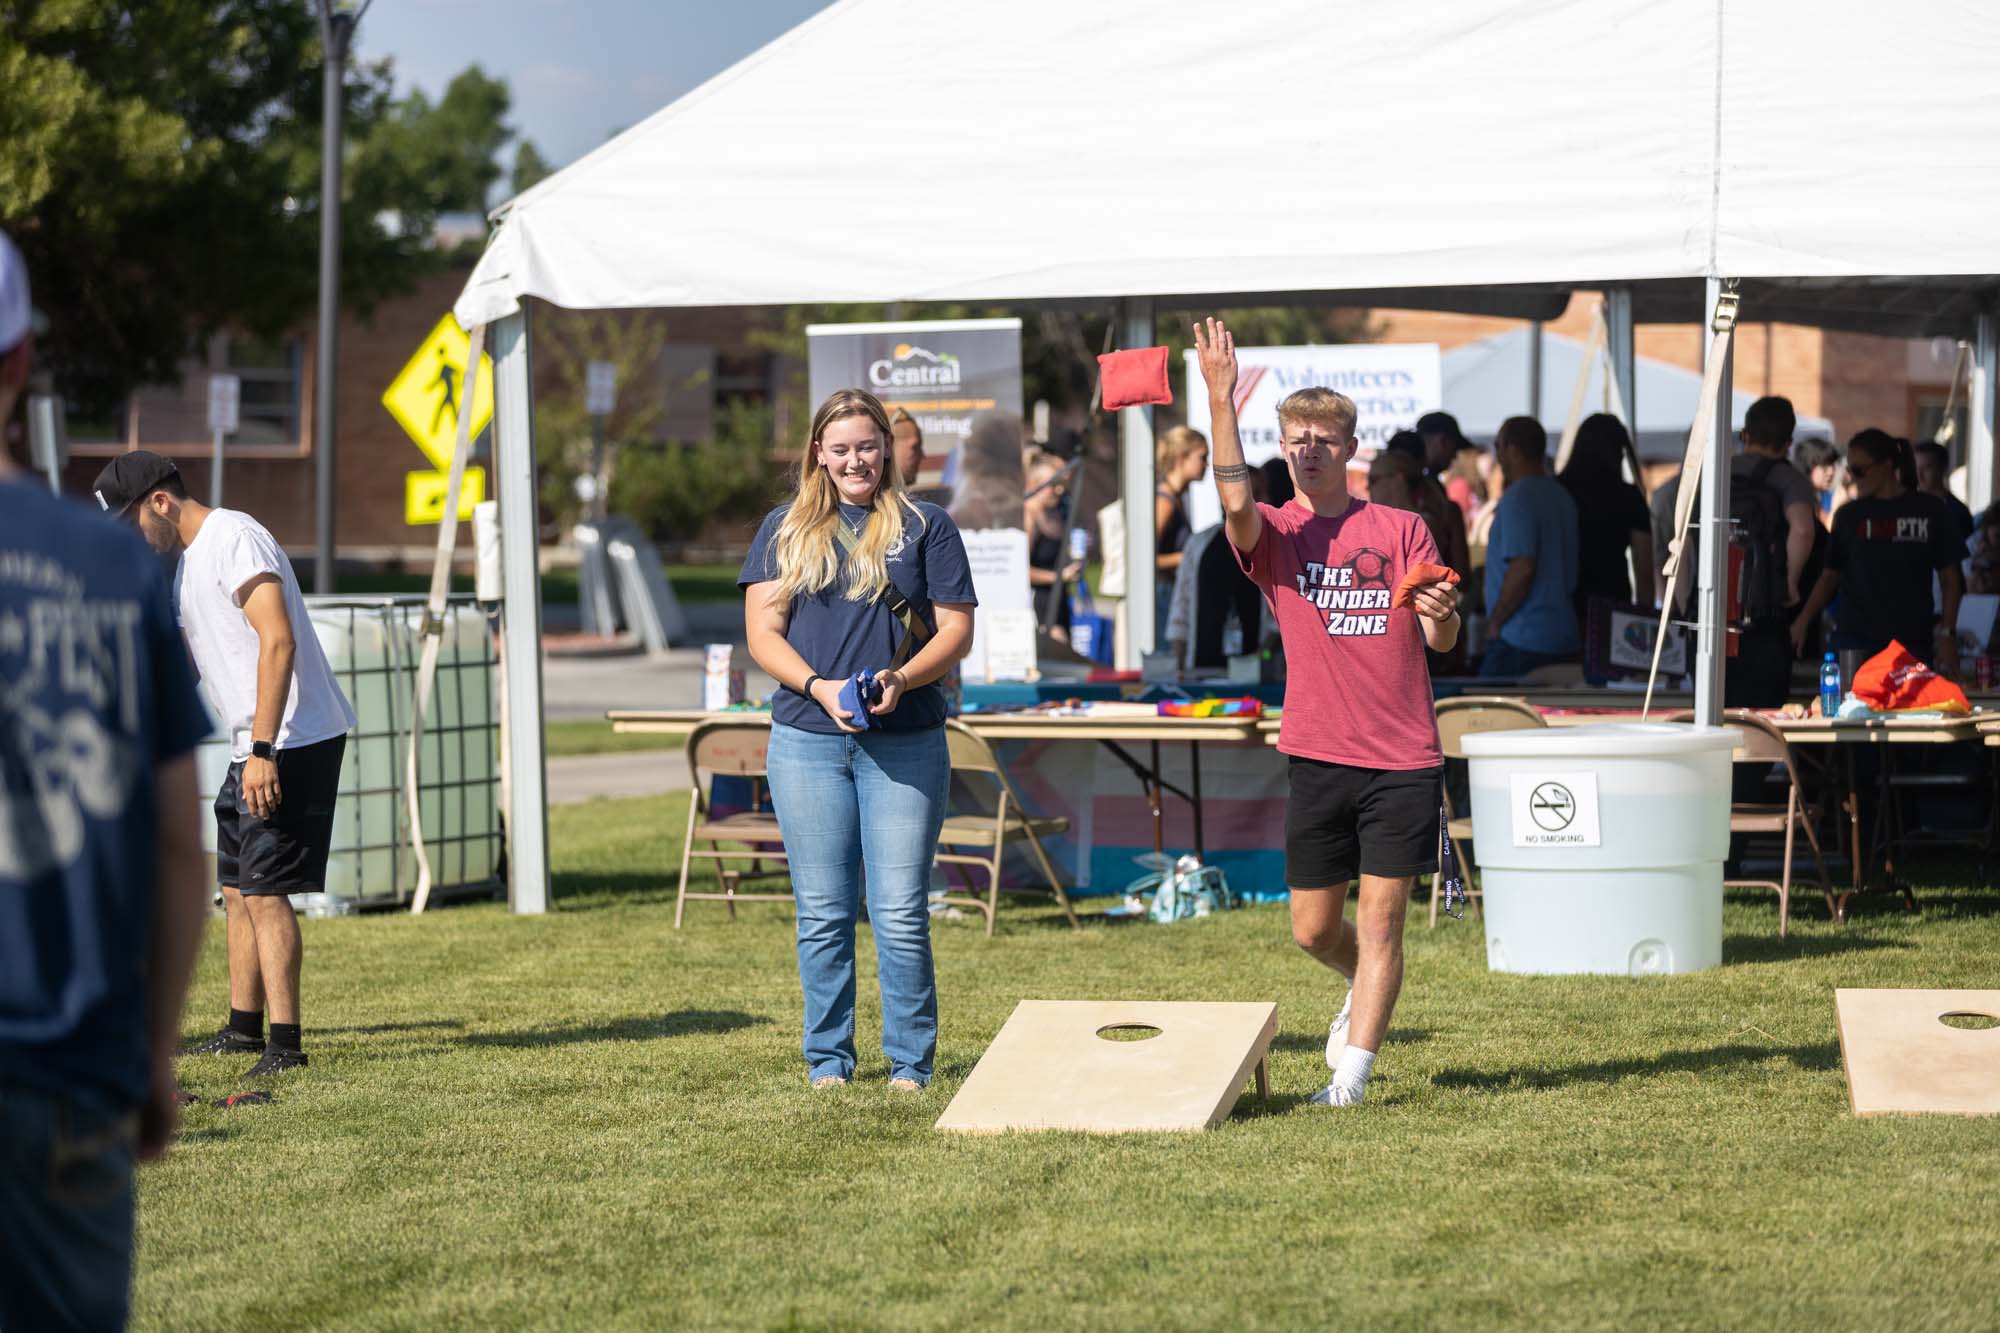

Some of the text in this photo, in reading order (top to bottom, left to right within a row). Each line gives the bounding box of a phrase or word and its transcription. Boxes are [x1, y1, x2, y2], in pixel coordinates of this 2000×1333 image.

[870, 360, 961, 387] Central
[1274, 367, 1413, 388] Volunteers
[1356, 399, 1417, 414] erica
[1896, 517, 1929, 539] PTK
[1305, 561, 1353, 587] THE
[1327, 612, 1388, 635] ZONE
[1525, 834, 1585, 843] NO SMOKING
